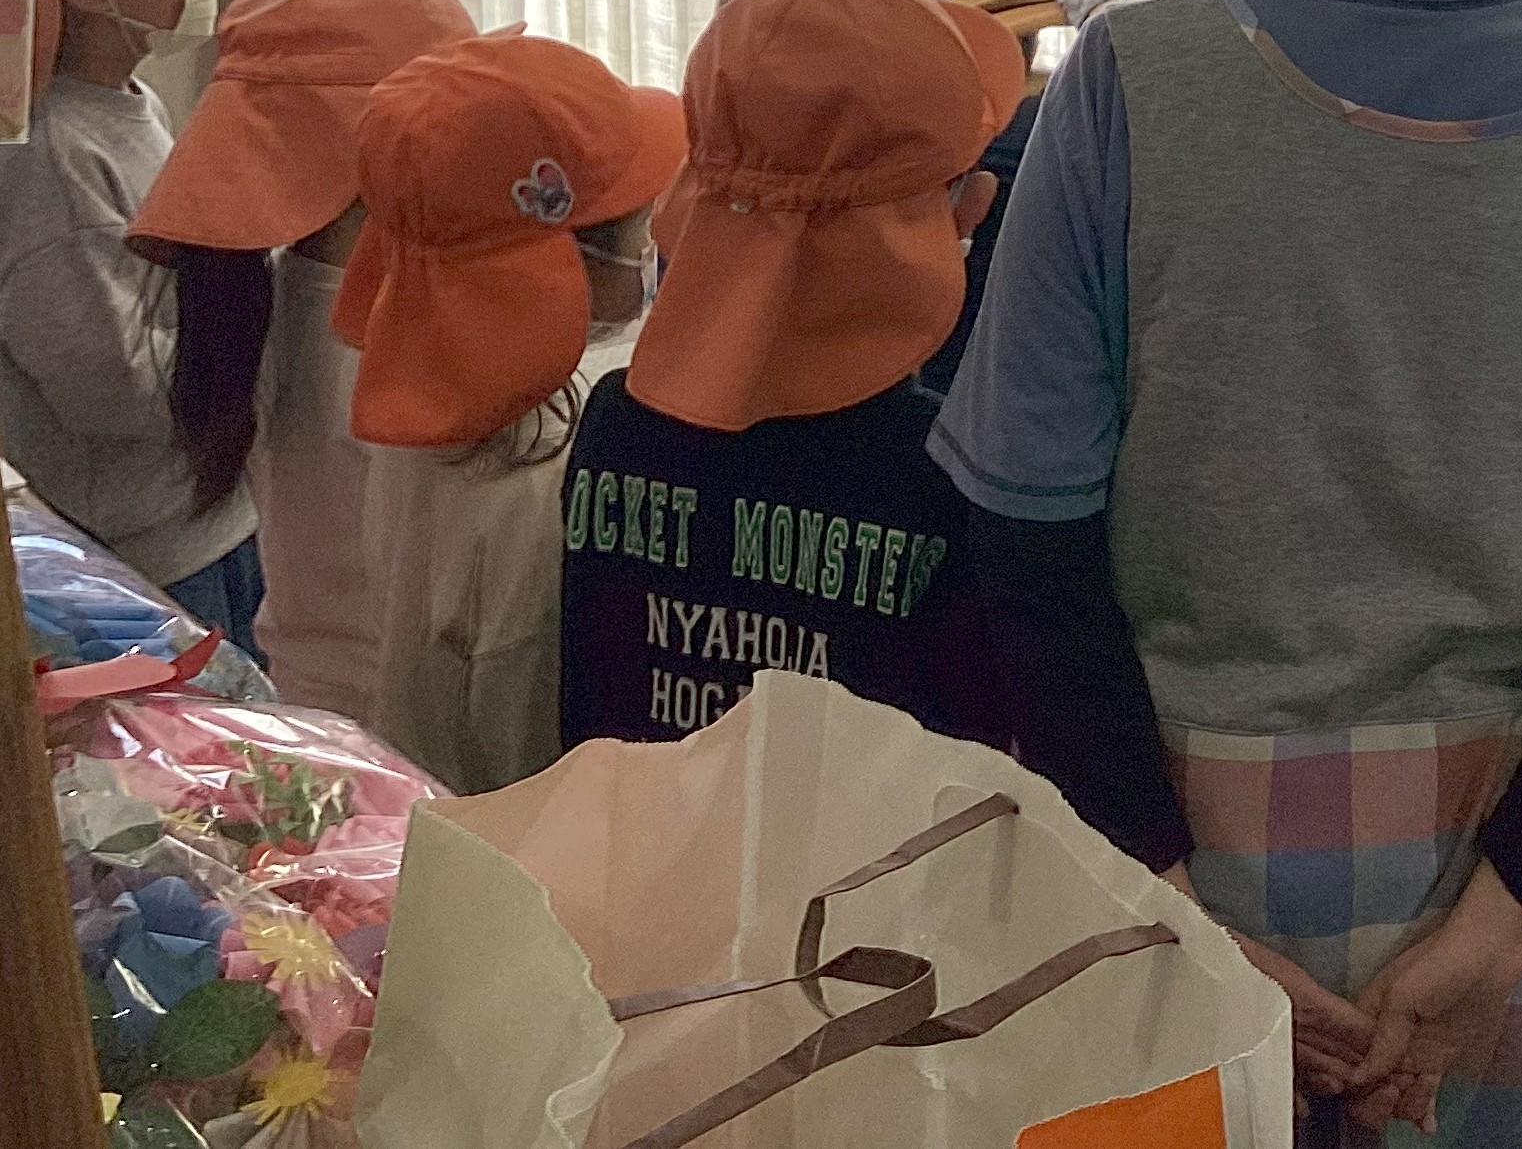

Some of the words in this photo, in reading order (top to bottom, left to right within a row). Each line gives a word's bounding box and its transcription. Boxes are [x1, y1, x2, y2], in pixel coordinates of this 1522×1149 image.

[566, 468, 698, 568] OCKET
[646, 592, 829, 678] NYAHOJA
[650, 667, 753, 729] HOG
